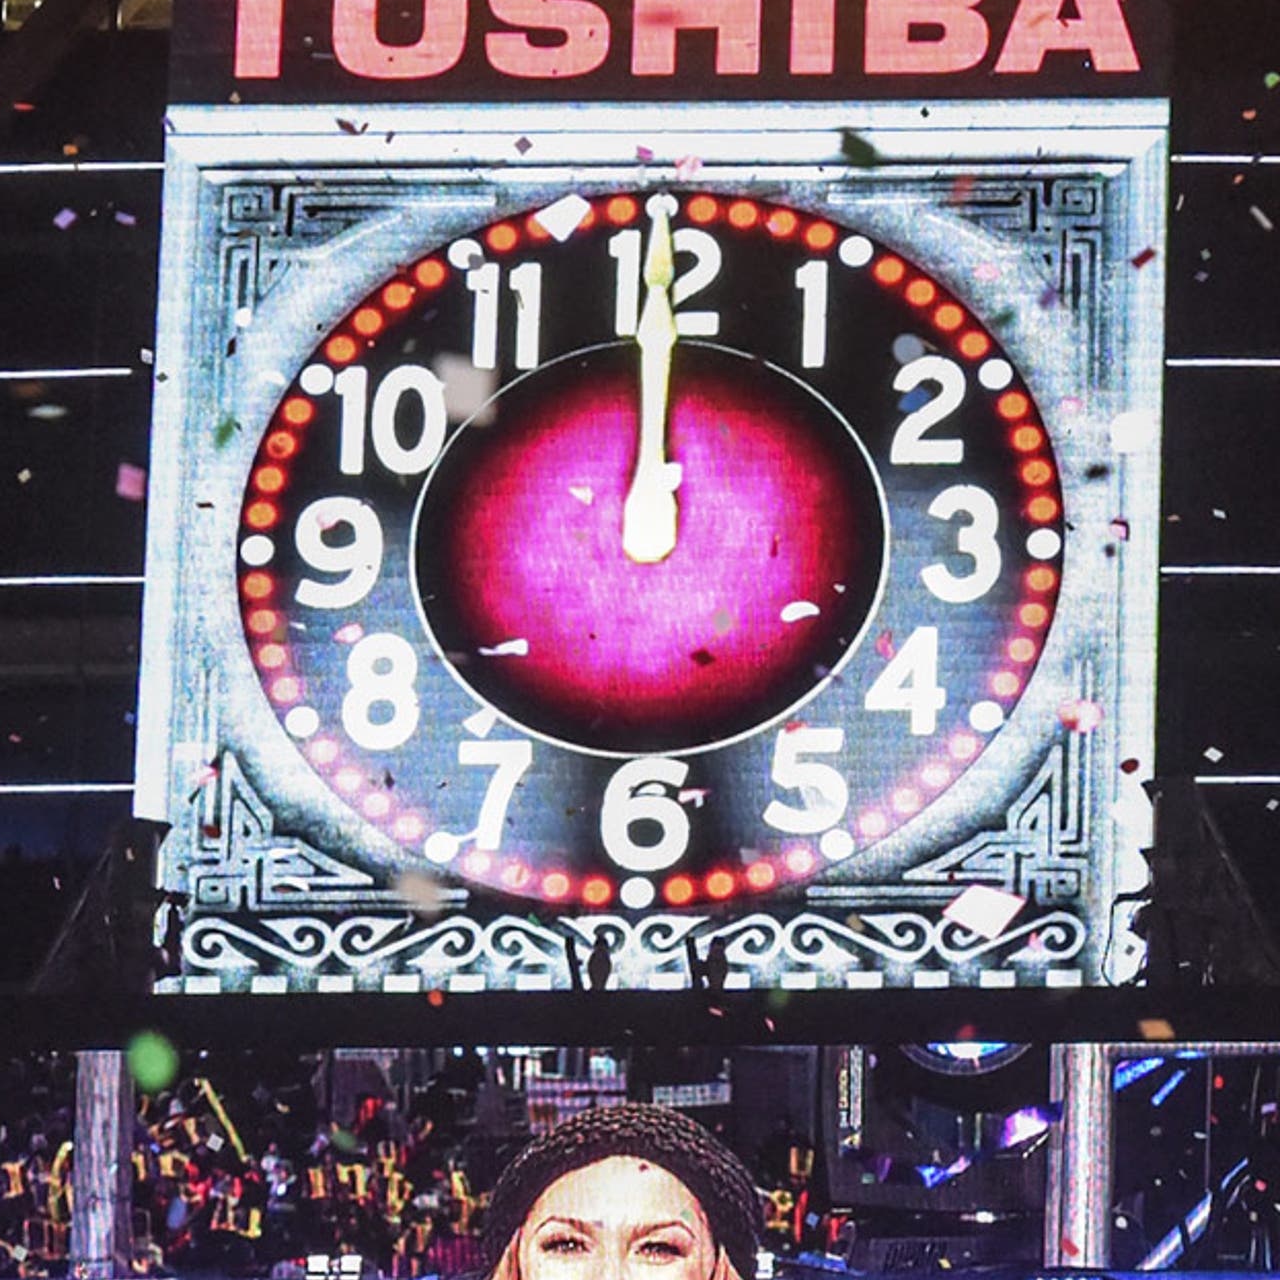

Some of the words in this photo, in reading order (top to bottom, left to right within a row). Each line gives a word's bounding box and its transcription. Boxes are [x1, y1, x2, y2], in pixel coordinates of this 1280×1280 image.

[467, 262, 541, 369] 11
[608, 227, 722, 337] 12
[796, 260, 827, 369] 1
[334, 365, 448, 475] 10
[891, 356, 966, 465] 2
[295, 497, 384, 610] 9
[920, 485, 1002, 603] 3
[341, 632, 421, 751] 8
[863, 626, 946, 736] 4
[457, 738, 533, 852] 7
[600, 756, 690, 872] 6
[763, 727, 848, 834] 5
